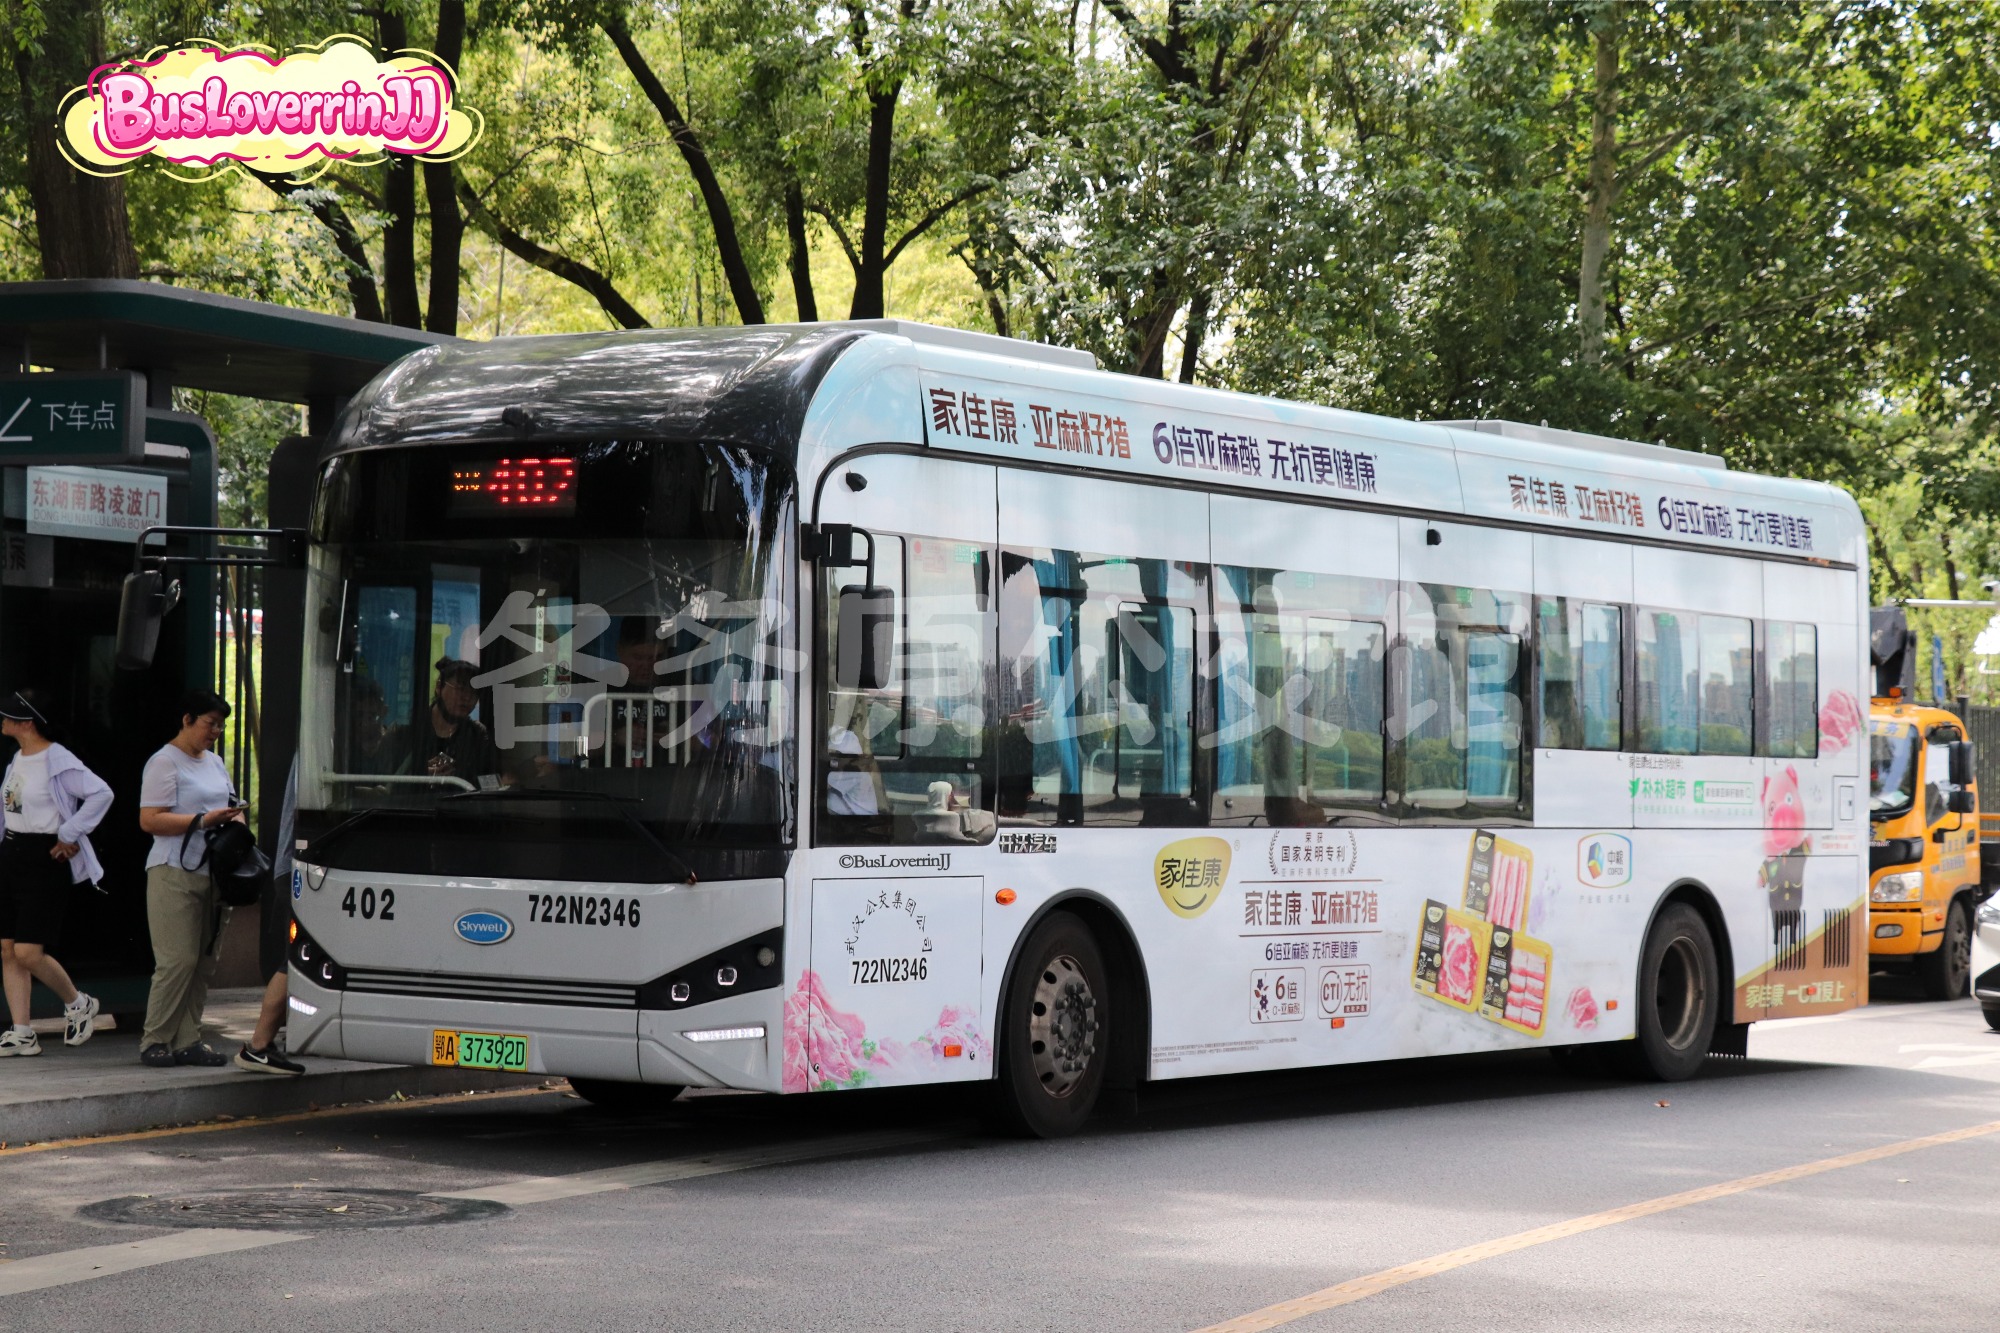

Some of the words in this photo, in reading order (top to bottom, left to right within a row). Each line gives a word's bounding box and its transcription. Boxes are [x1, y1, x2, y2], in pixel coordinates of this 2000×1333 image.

[41, 400, 116, 432] 下车点
[1152, 421, 1262, 478] 6倍亚麻酸
[33, 476, 161, 519] 东湖南路凌波门
[33, 510, 59, 522] DONG
[62, 512, 73, 523] HU
[75, 514, 93, 524] NAN
[106, 517, 126, 528] LING
[128, 518, 140, 529] BO
[1658, 496, 1733, 540] 6倍亚麻酸
[1736, 507, 1814, 551] 无抗更健康
[1641, 778, 1687, 799] 朴朴超市
[999, 833, 1057, 853] 开沃汽车
[1281, 845, 1346, 863] 国家发明专利
[1607, 850, 1624, 865] 中粮
[1160, 858, 1222, 889] 家佳康
[1607, 867, 1624, 876] COFCO
[342, 886, 395, 920] 402
[528, 894, 641, 928] 722N2346
[459, 920, 505, 936] Skywell
[844, 889, 933, 956] 武汉公交集团公司
[1265, 942, 1310, 961] 6倍亚麻酸
[1312, 940, 1358, 960] 无抗更健康
[852, 957, 928, 984] 722N2346
[1275, 975, 1298, 1000] 6倍
[1322, 983, 1340, 1002] CTI
[1343, 970, 1369, 1002] 无抗
[1745, 984, 1786, 1009] 家佳康
